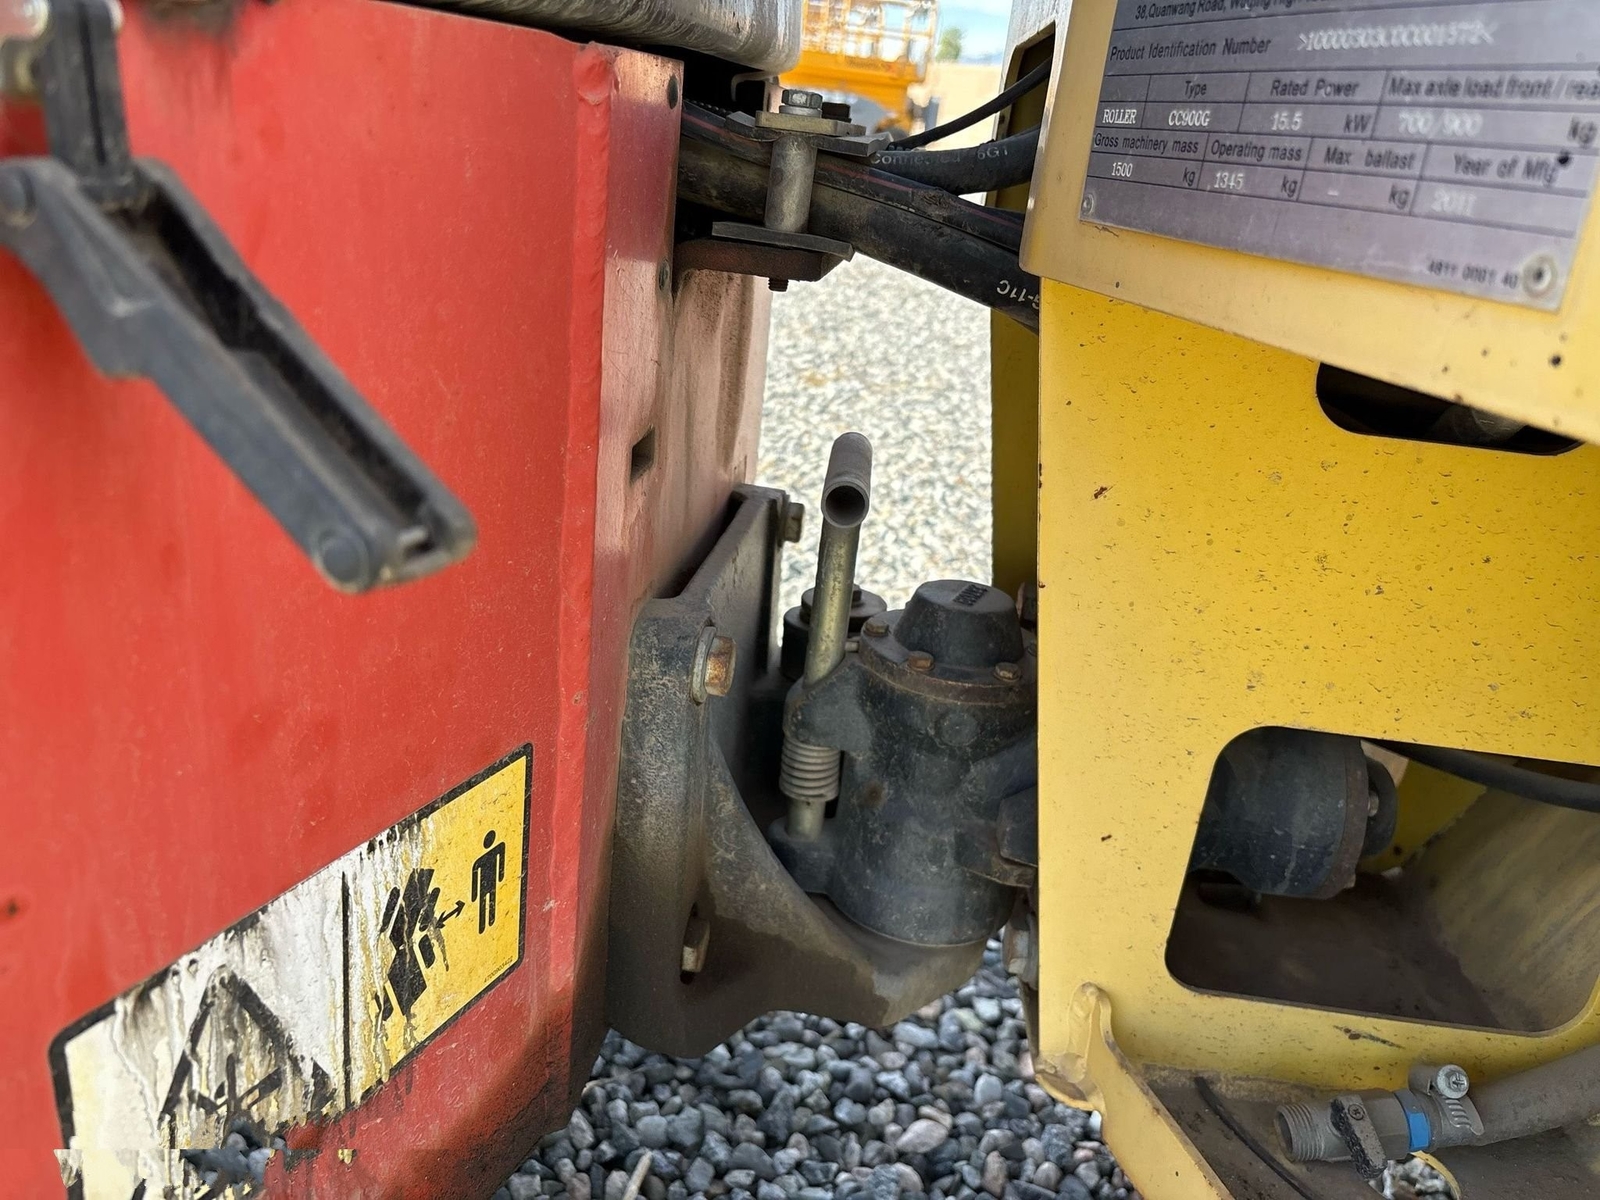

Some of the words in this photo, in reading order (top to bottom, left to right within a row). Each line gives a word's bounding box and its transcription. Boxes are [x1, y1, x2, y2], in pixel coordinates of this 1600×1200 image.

[1110, 46, 1144, 61] Product
[1148, 39, 1216, 59] Identification
[1222, 38, 1271, 56] Number
[1184, 80, 1207, 99] Type
[1270, 79, 1309, 97] Rated
[1315, 78, 1360, 97] Power
[1388, 77, 1422, 96] Max
[1424, 78, 1462, 97] axle
[1463, 76, 1502, 98] load
[1102, 109, 1137, 124] ROLLER
[1168, 110, 1211, 126] CC900G
[1271, 110, 1302, 131] 15.5
[1343, 114, 1371, 133] kW
[1095, 132, 1119, 147] Gross
[1122, 136, 1168, 154] machinery
[1172, 142, 1199, 154] mass
[1211, 139, 1265, 162] Operating
[1268, 146, 1302, 161] mass
[1324, 147, 1353, 165] Max
[1364, 148, 1417, 170] ballast
[1453, 152, 1494, 176] Year
[1496, 155, 1519, 178] of
[1111, 162, 1133, 177] 1500
[1182, 167, 1196, 187] kg
[1214, 172, 1244, 190] 1345
[1280, 175, 1299, 198] kg
[1388, 184, 1410, 210] kg
